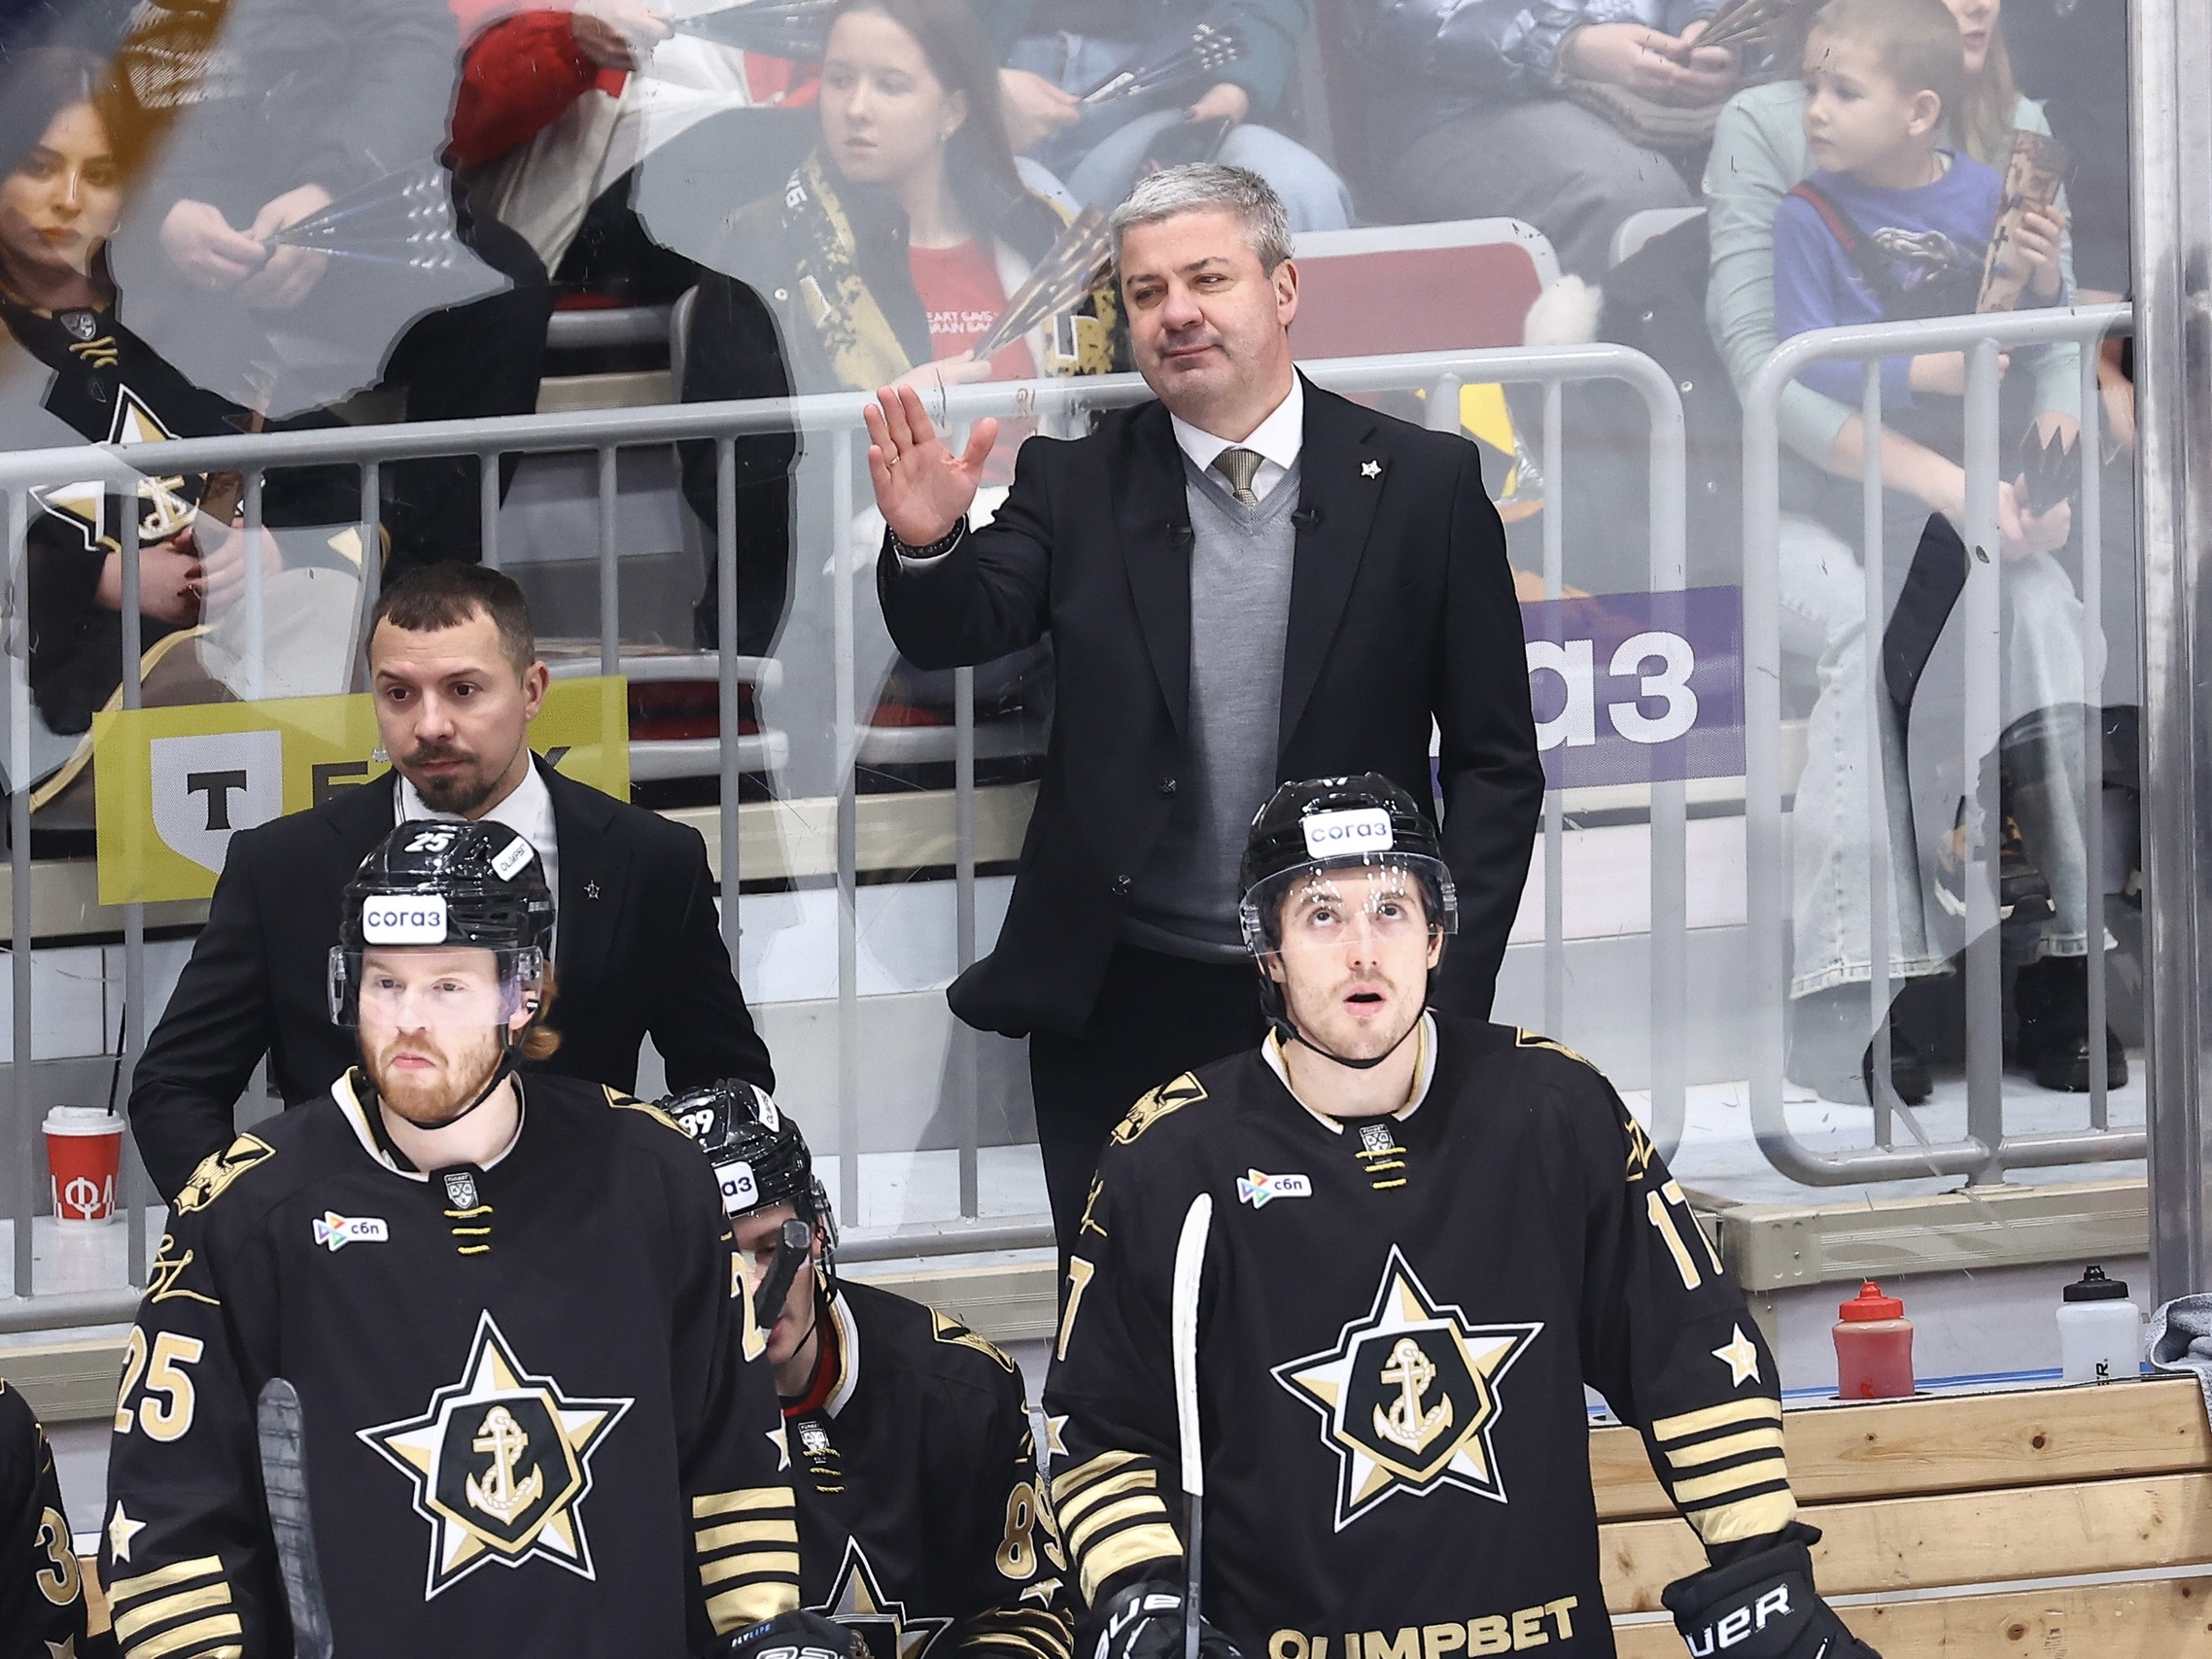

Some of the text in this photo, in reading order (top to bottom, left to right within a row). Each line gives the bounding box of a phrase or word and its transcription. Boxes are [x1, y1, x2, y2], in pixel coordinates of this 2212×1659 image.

[1311, 822, 1387, 843] согаз
[403, 832, 456, 853] 25
[367, 911, 440, 927] согаз
[1274, 1178, 1302, 1191] сбп
[351, 1223, 379, 1234] сбп
[114, 1325, 204, 1442] 25
